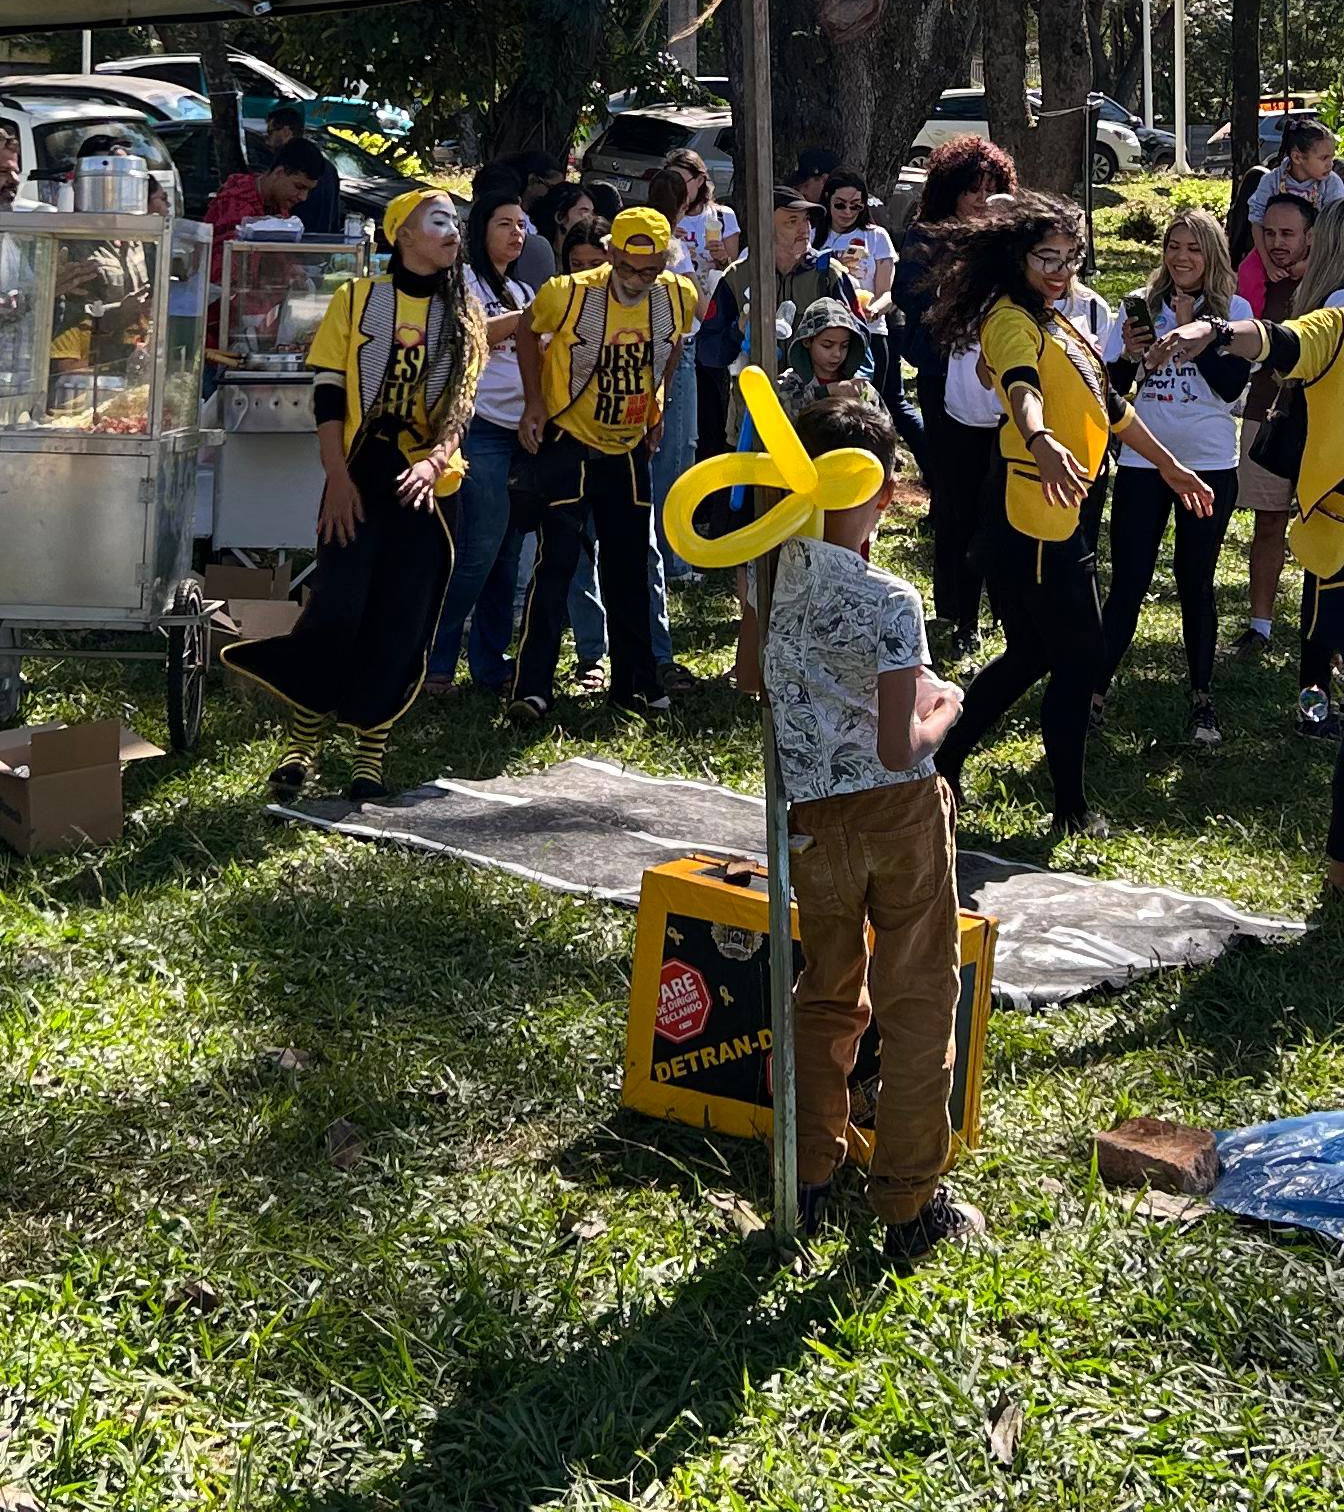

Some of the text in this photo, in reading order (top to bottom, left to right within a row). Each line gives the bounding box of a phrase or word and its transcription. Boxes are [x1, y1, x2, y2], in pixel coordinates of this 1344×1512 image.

[597, 366, 644, 395] CELE
[593, 392, 625, 425] RE
[660, 972, 697, 1003] ARE
[667, 990, 700, 1011] DIRIGIR
[658, 1000, 703, 1026] TECLANDO
[653, 1027, 773, 1083] DETRAN-D
